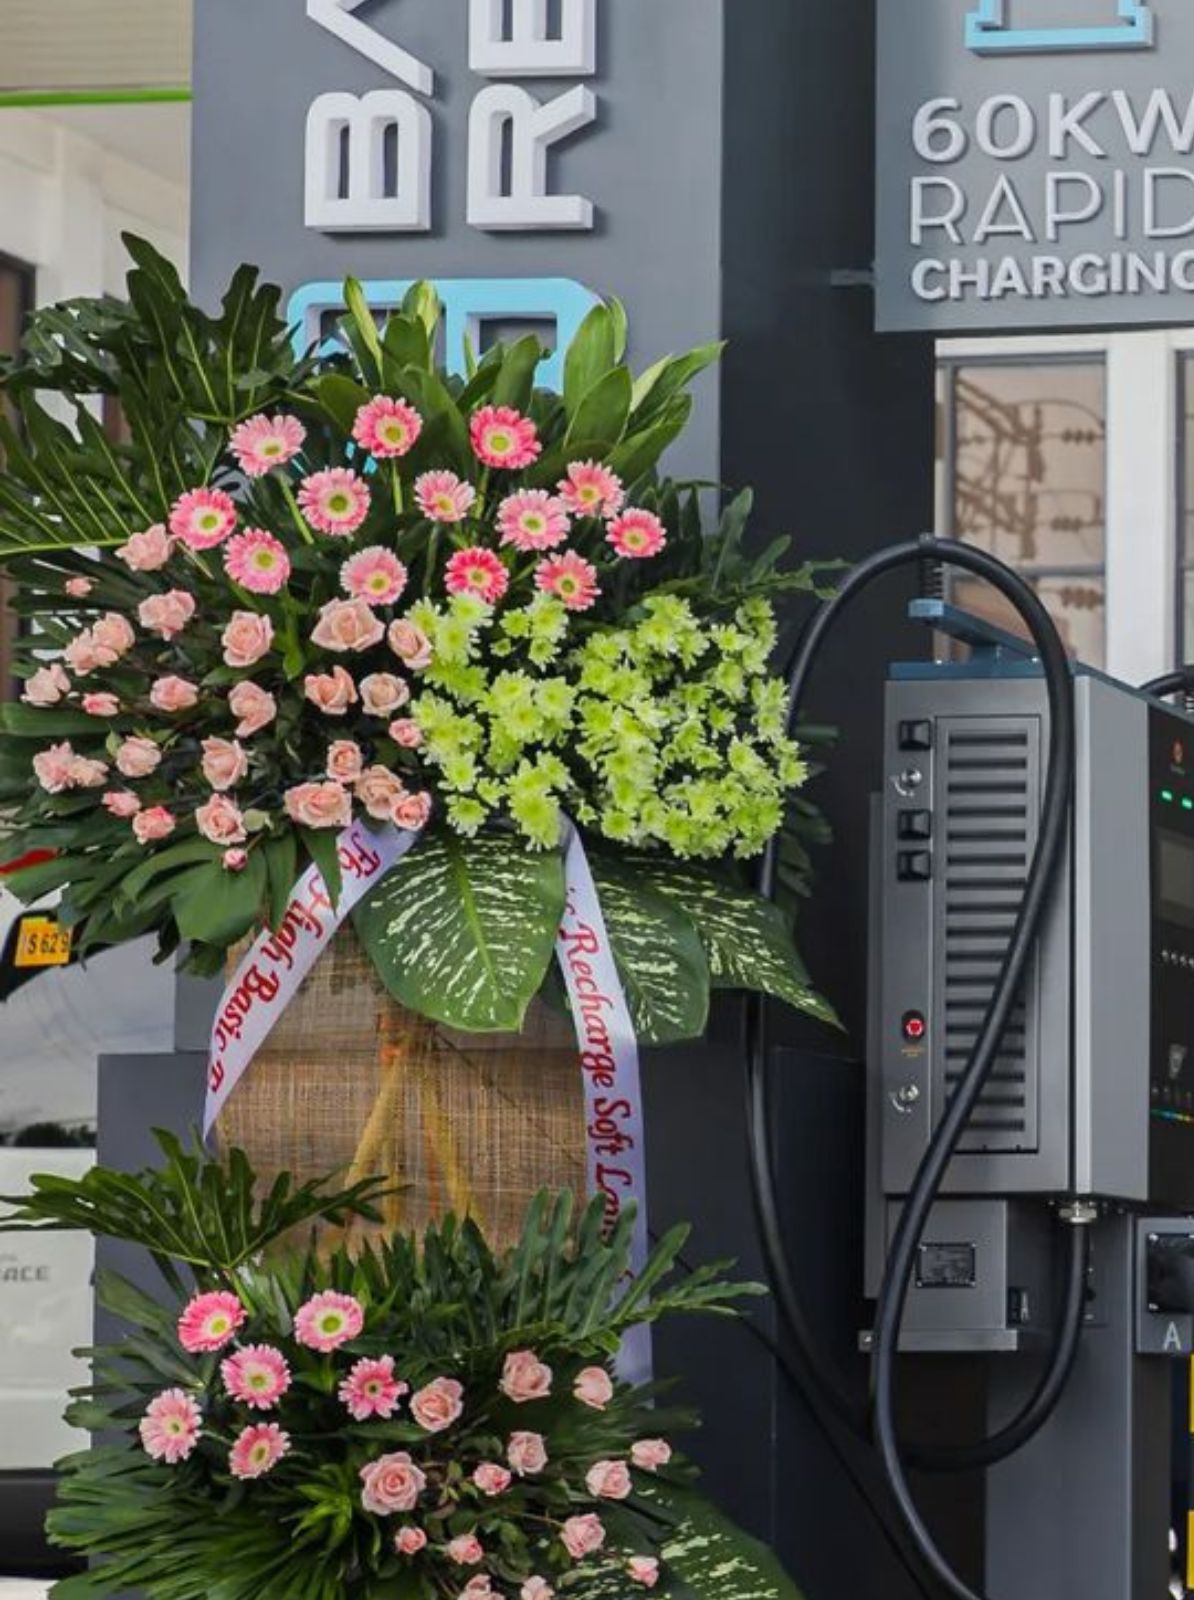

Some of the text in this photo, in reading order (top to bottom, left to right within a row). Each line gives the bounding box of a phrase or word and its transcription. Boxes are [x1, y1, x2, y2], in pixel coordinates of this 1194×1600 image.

[558, 921, 614, 1089] Recharge
[588, 1097, 633, 1156] Soft
[1163, 1320, 1181, 1351] A
